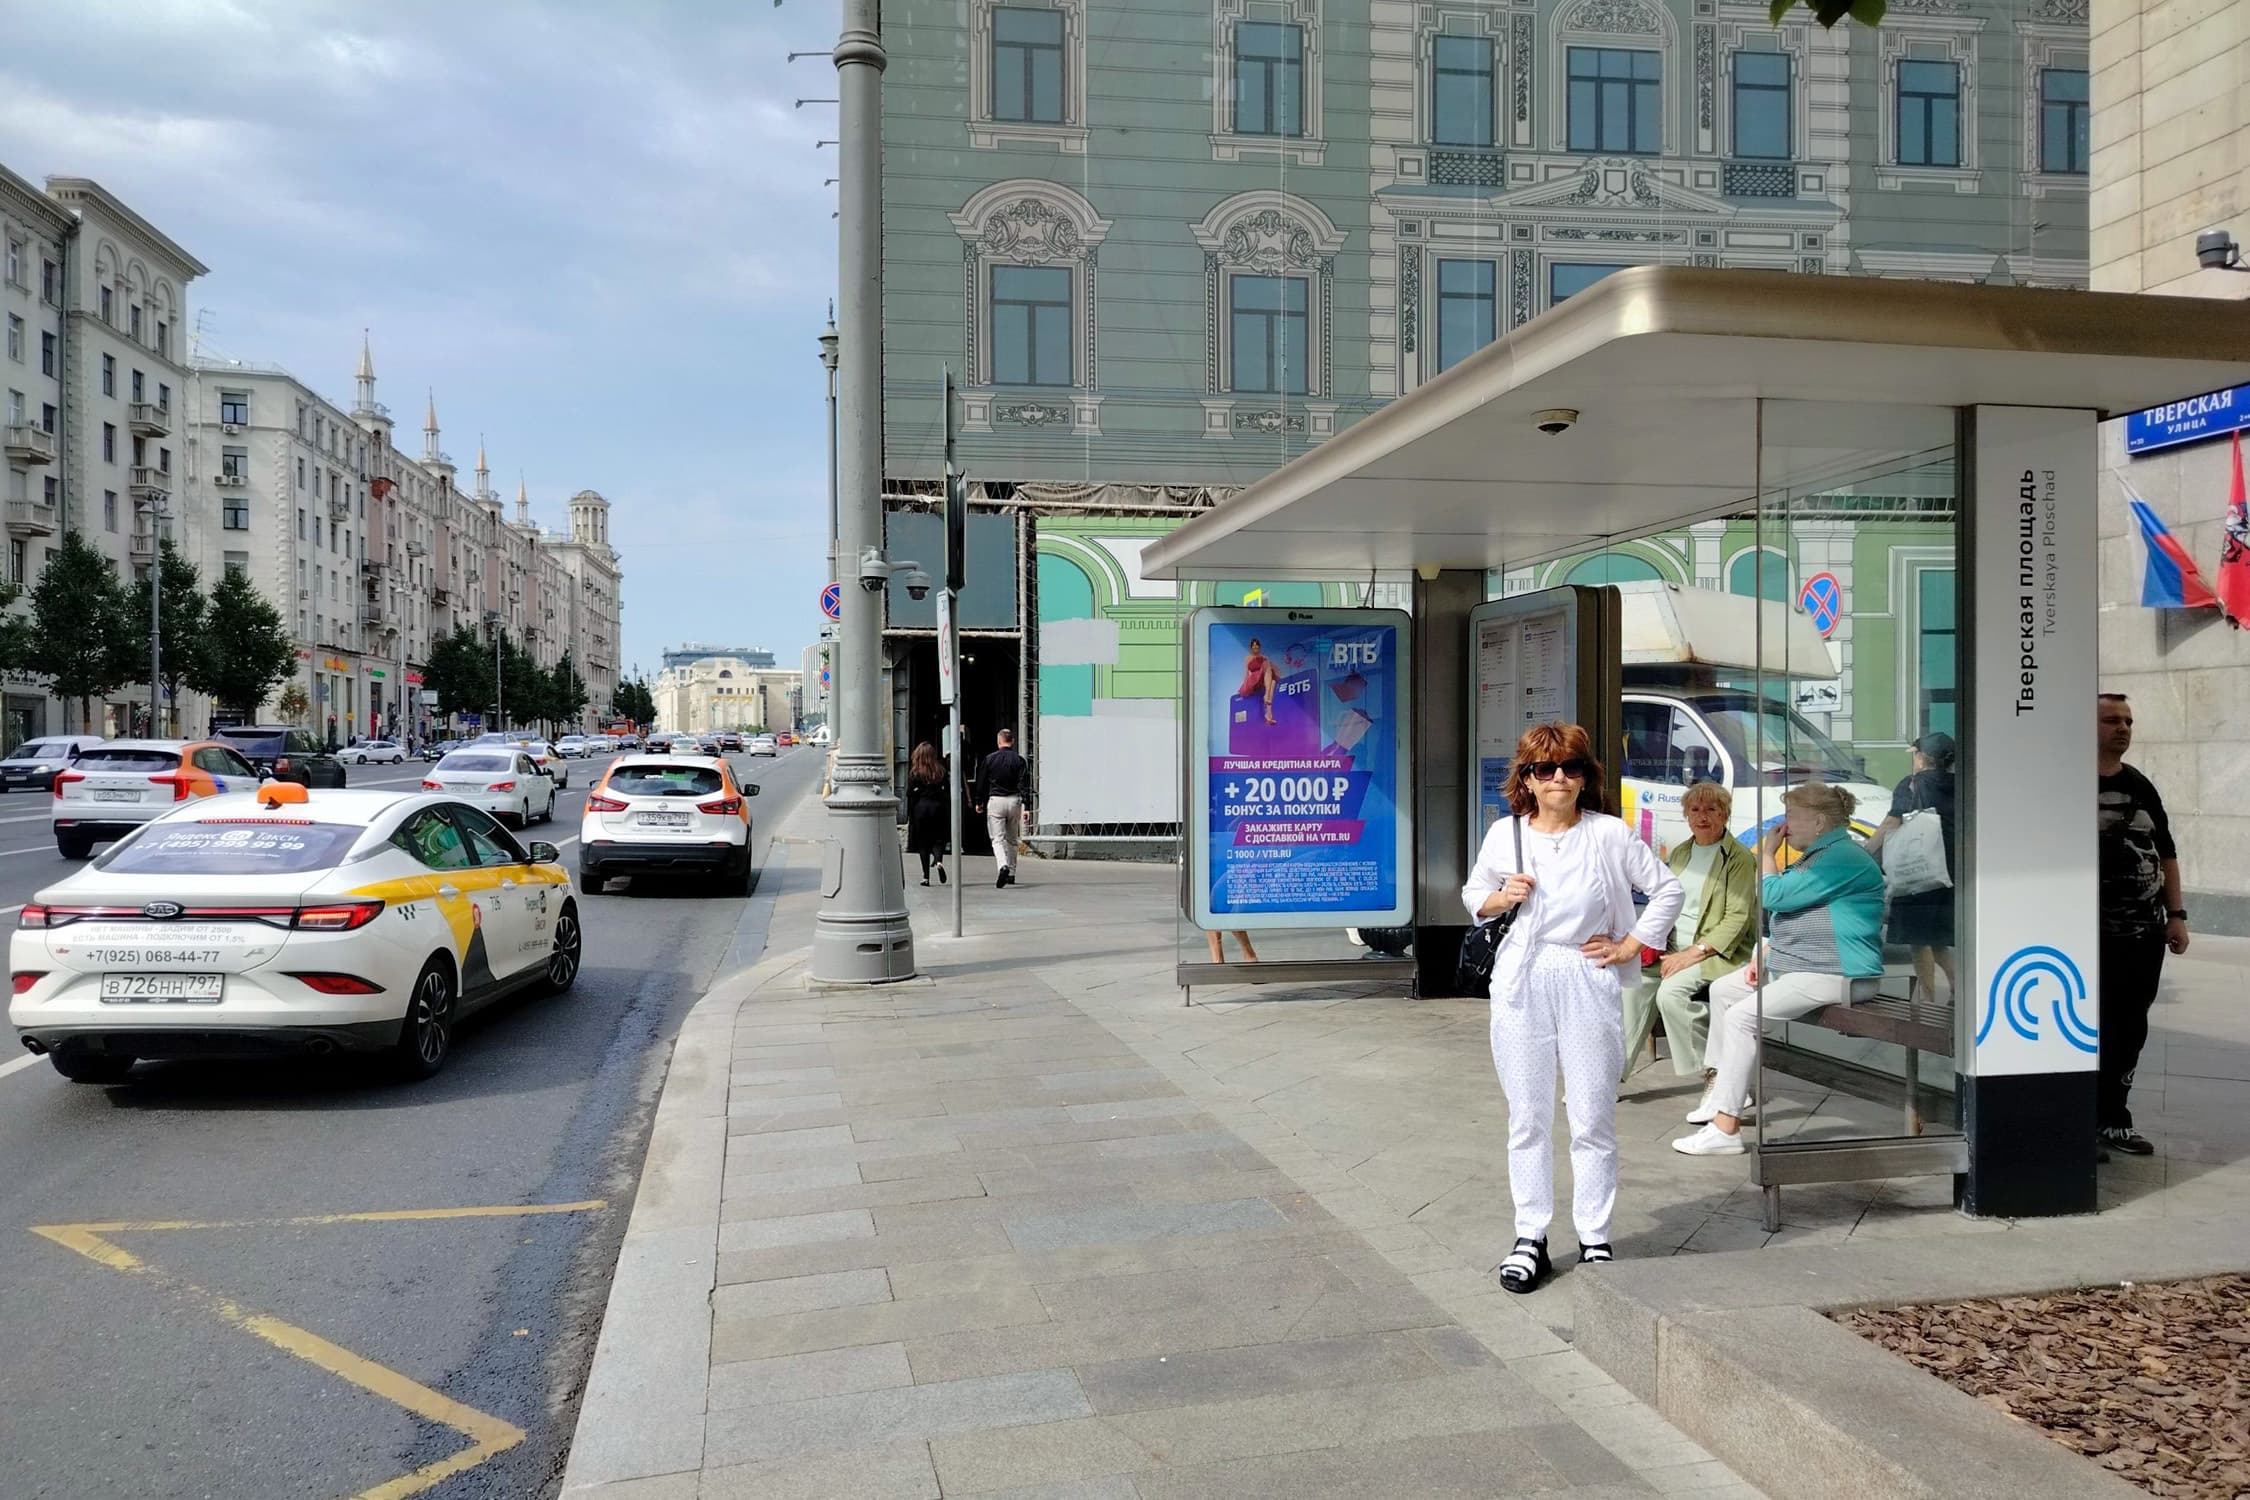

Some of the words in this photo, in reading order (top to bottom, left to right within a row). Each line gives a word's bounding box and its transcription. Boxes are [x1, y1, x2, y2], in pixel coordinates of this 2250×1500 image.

[2143, 389, 2233, 427] ТВЕРСКАЯ
[2167, 417, 2207, 435] УЛИЦА
[2042, 470, 2056, 547] Ploschad
[2020, 469, 2036, 587] площадь
[2043, 553, 2058, 638] Tverskaya
[1334, 643, 1377, 664] ВТБ
[2016, 596, 2038, 717] Тверская
[1288, 678, 1311, 696] ВТБ
[1223, 760, 1261, 770] ЛУЧШАЯ
[1262, 760, 1313, 771] КРЕДИТНАЯ
[1313, 759, 1342, 769] КАРТА
[1224, 781, 1240, 799] +
[1244, 777, 1276, 803] 20
[1280, 776, 1329, 803] 000
[1224, 804, 1264, 816] БОНУС
[1265, 804, 1281, 816] ЗА
[1284, 803, 1341, 816] ПОКУПКИ
[1244, 824, 1293, 833] ЗАКАЖИТЕ
[1294, 823, 1323, 833] КАРТУ
[255, 831, 301, 842] Такси
[1245, 834, 1252, 844] С
[1252, 832, 1304, 845] ДОСТАВКОЙ
[1306, 833, 1319, 843] НА
[1320, 832, 1351, 843] VTB.RU
[160, 840, 212, 850] (495)
[213, 840, 250, 849] 999
[250, 841, 277, 849] 99
[278, 842, 306, 851] 99
[1234, 849, 1255, 859] 1000
[1262, 849, 1292, 859] VTB.RU
[147, 904, 175, 914] JAC
[109, 926, 154, 934] МАШИНЫ
[159, 926, 195, 935] ДАДИМ
[196, 926, 210, 934] ОТ
[98, 934, 139, 942] МАШИНА
[146, 934, 207, 942] ПОДКЛЮЧИМ
[208, 935, 222, 943] ОТ
[86, 950, 141, 965] +7(925)
[145, 950, 221, 963] 068-44-77
[107, 976, 185, 996] В726НН
[187, 975, 217, 991] 797
